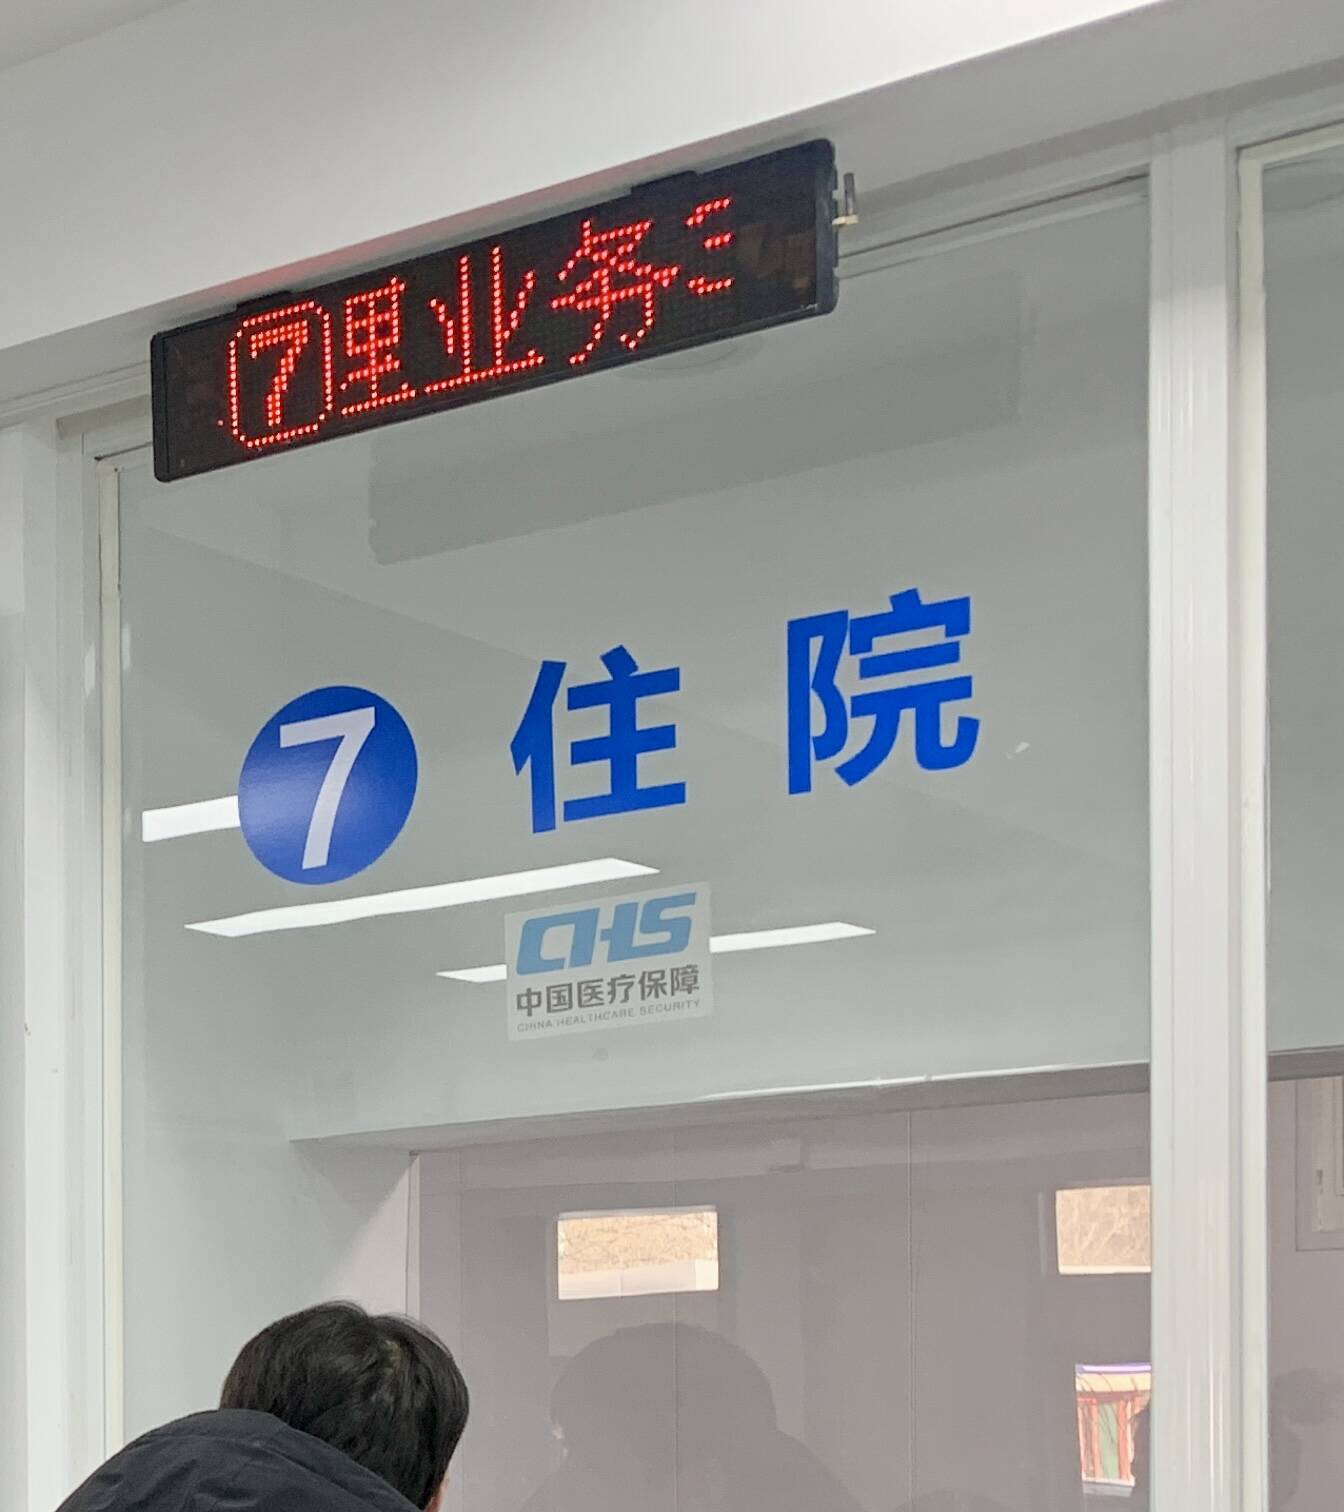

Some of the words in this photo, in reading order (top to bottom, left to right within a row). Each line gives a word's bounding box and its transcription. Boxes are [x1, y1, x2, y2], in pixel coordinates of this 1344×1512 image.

[510, 588, 981, 834] 住院
[516, 892, 697, 976] CHS
[516, 964, 700, 1017] 中国医疗保障
[517, 1018, 553, 1033] CHINA
[556, 1008, 635, 1026] HEALTHCARE
[639, 1000, 700, 1016] SECURITY
